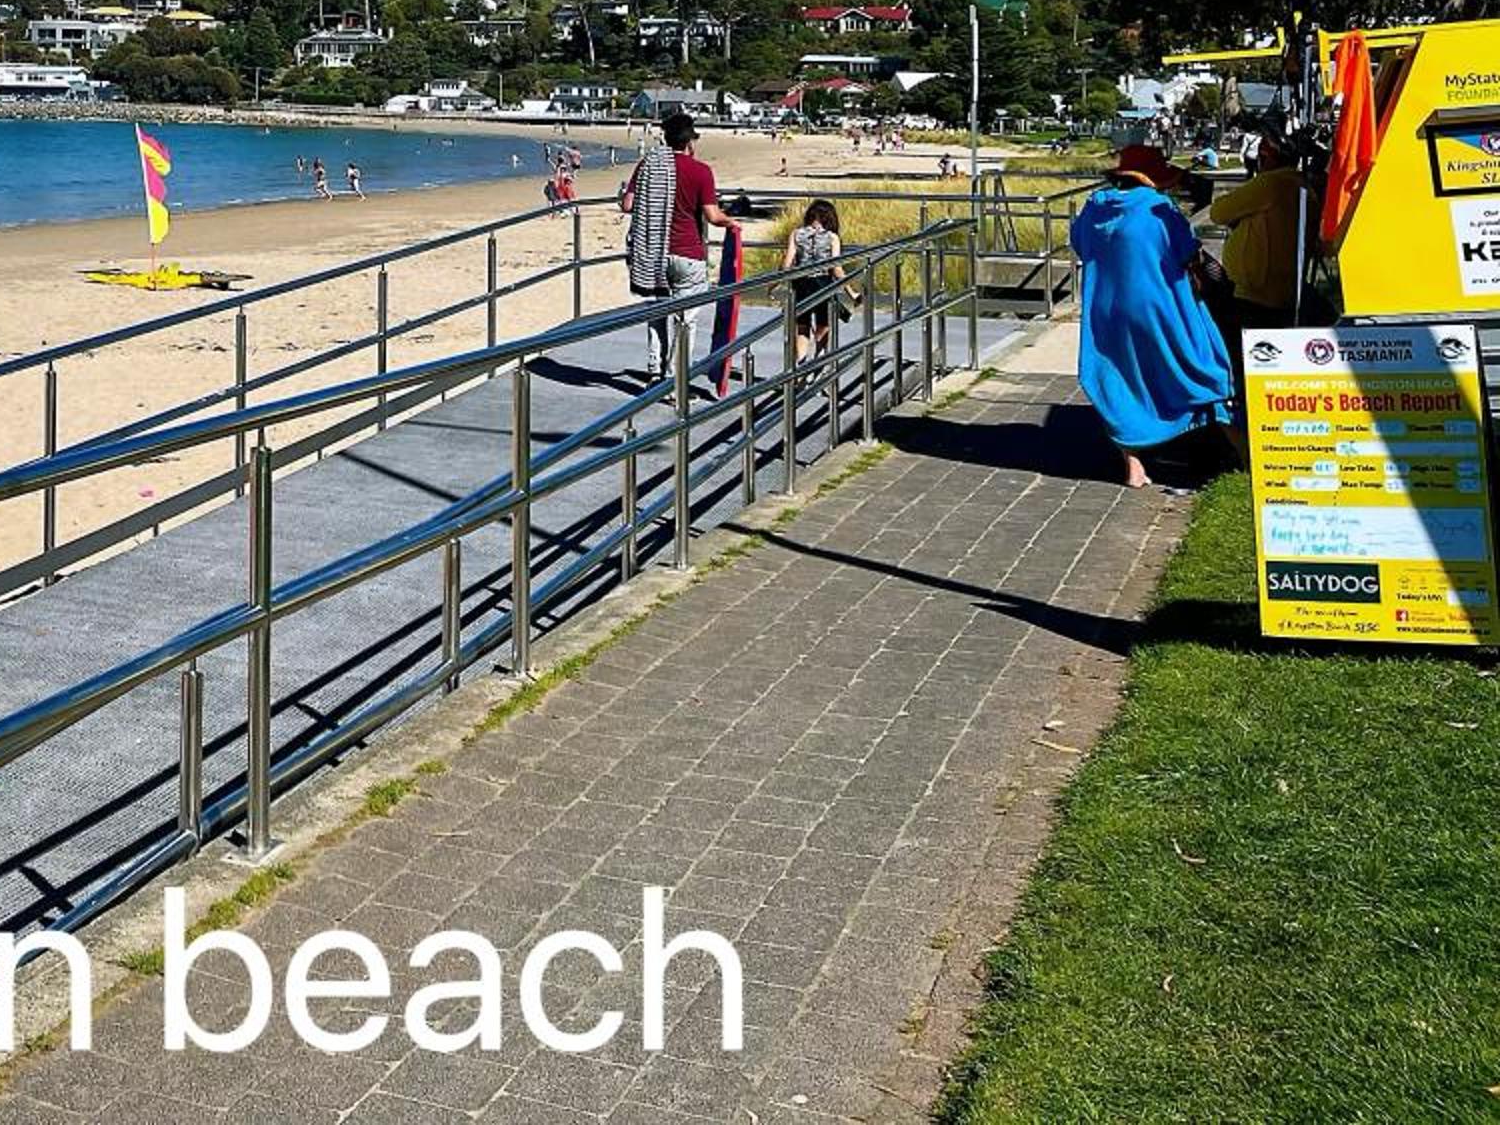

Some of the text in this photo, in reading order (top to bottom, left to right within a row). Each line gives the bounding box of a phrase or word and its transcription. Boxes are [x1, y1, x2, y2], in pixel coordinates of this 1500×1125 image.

[1445, 72, 1500, 89] MyStat
[1338, 348, 1412, 362] TASMANIA
[1265, 392, 1460, 413] Today's Beach Report
[1268, 570, 1379, 594] SALTYDOG
